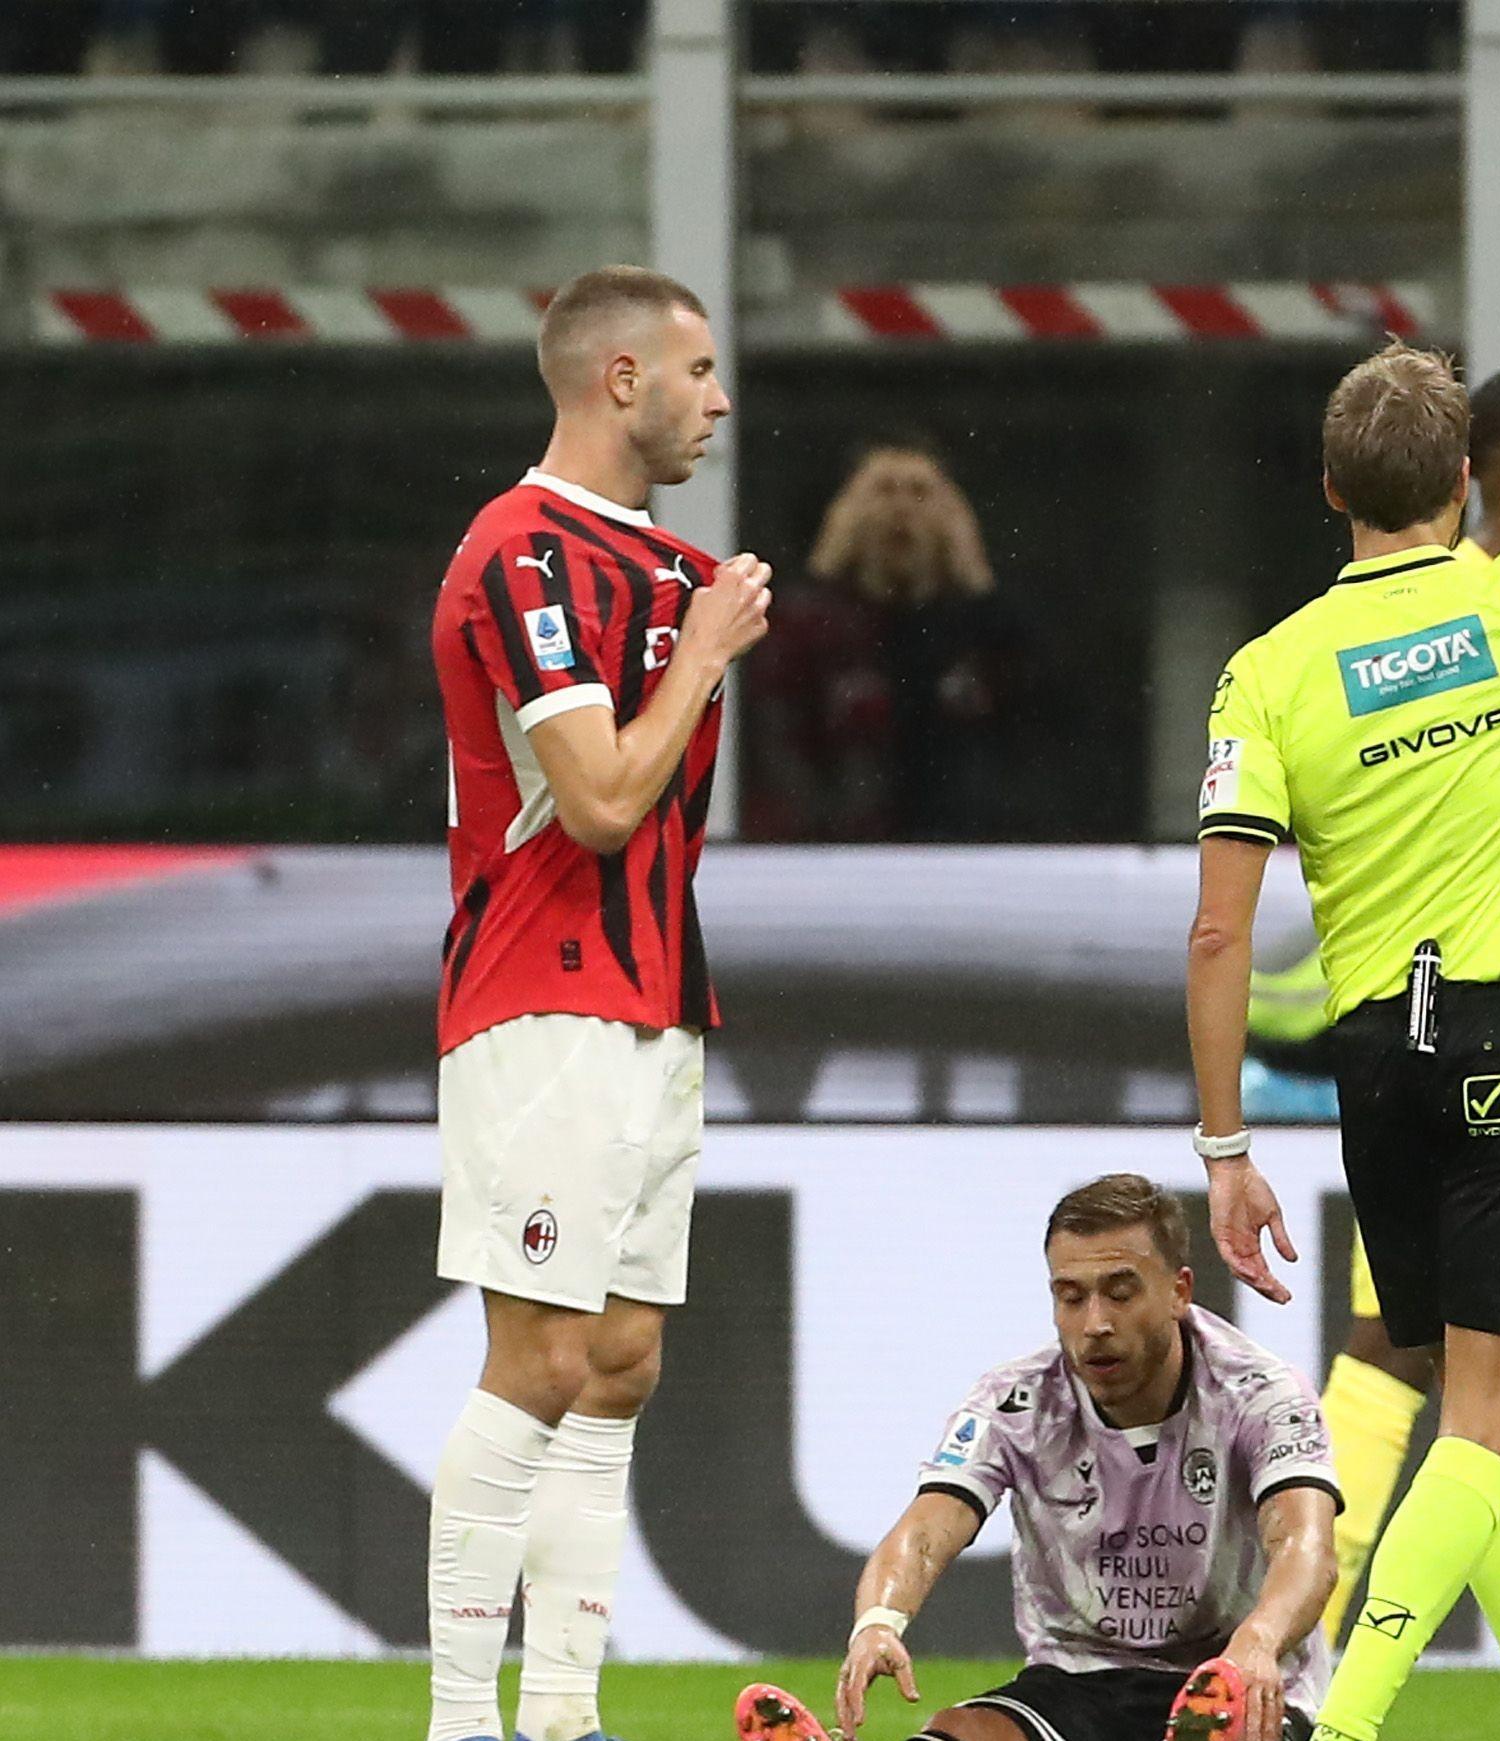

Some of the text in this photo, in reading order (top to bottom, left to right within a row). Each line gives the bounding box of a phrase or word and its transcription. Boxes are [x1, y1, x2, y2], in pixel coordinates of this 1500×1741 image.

[1100, 1522, 1207, 1550] IO SONO
[1099, 1555, 1170, 1578] FRIULI
[1096, 1585, 1198, 1609] VENEZIA
[1092, 1616, 1179, 1640] GIULIA
